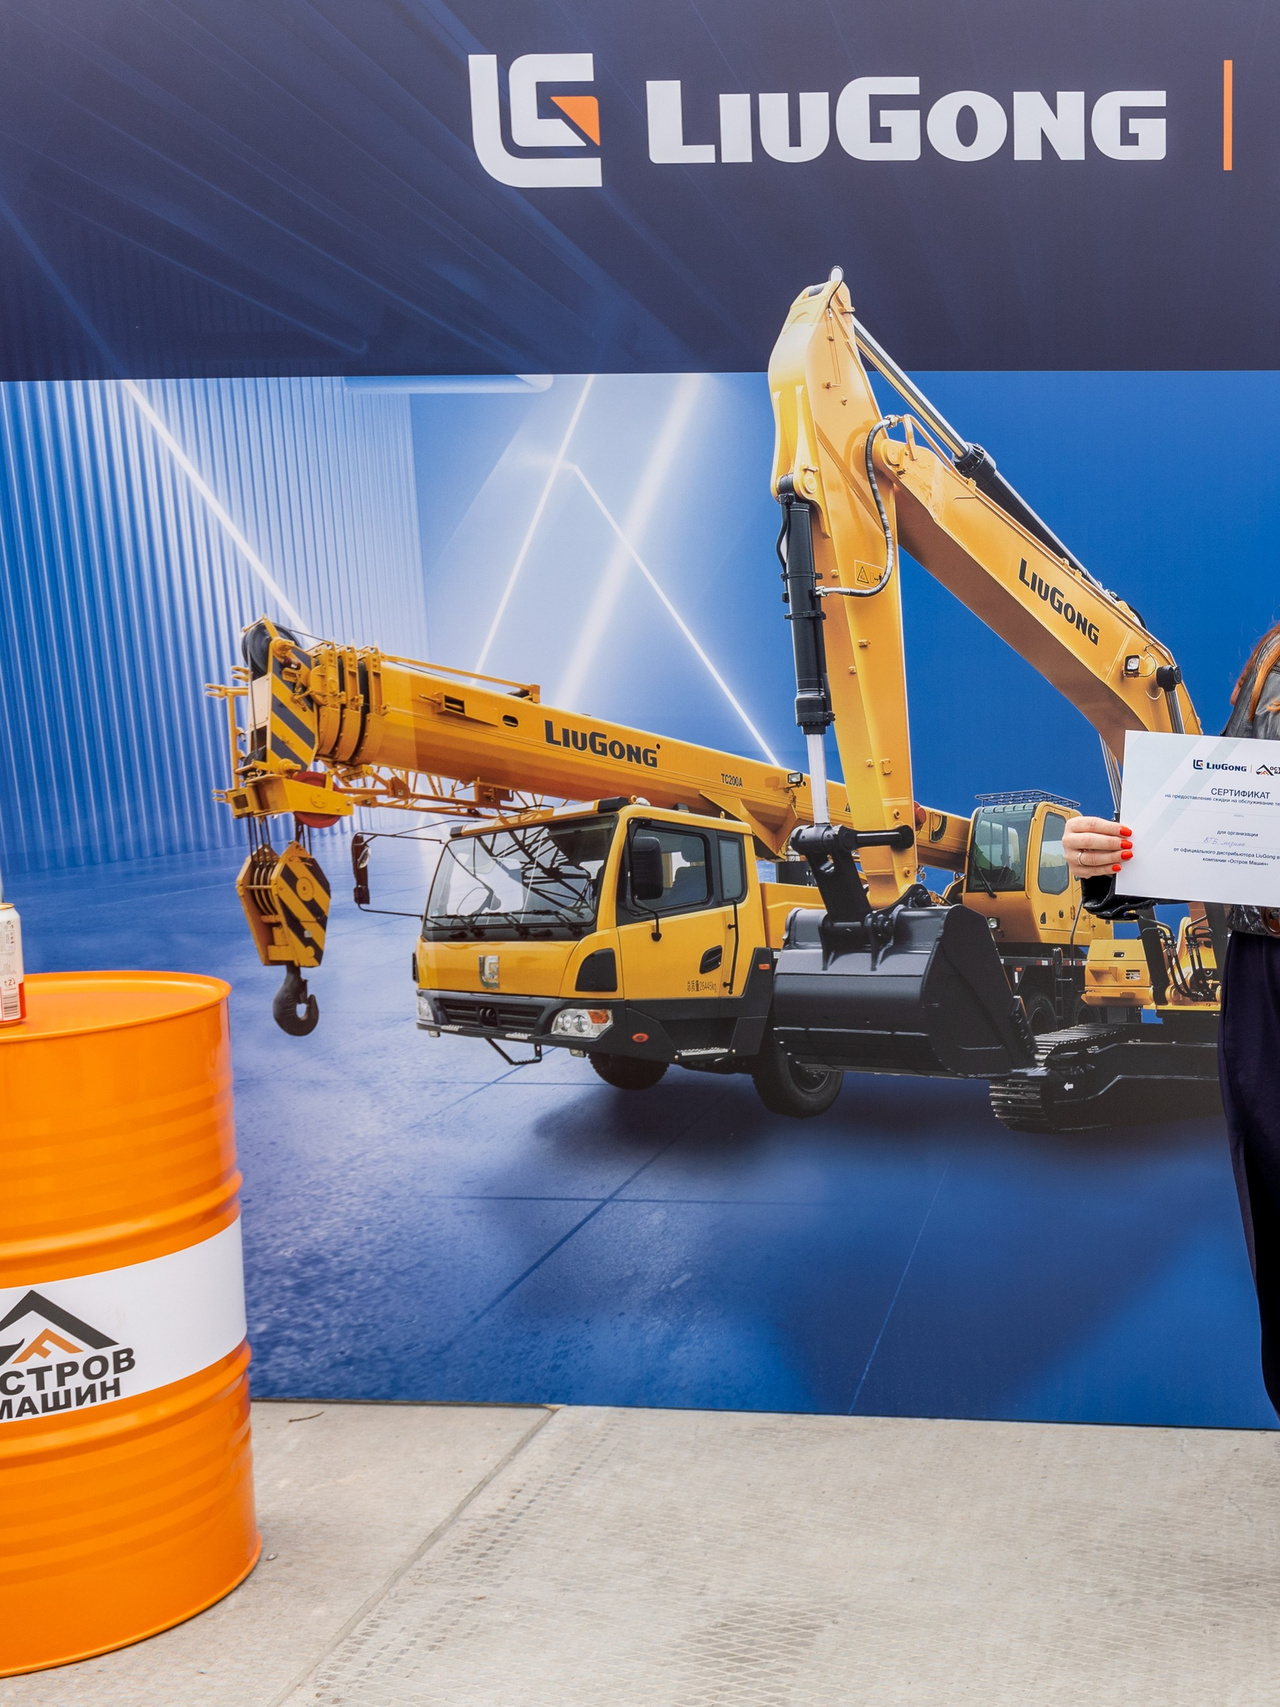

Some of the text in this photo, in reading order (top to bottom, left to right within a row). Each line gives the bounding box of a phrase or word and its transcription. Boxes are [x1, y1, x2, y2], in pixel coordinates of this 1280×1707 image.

[721, 773, 743, 788] TC200A
[1211, 788, 1270, 799] СЕРТИФИКАТ
[1227, 830, 1259, 838] организации
[1180, 847, 1216, 855] официального
[1216, 850, 1255, 858] дистрибьютора
[0, 1347, 136, 1396] СТРОВ
